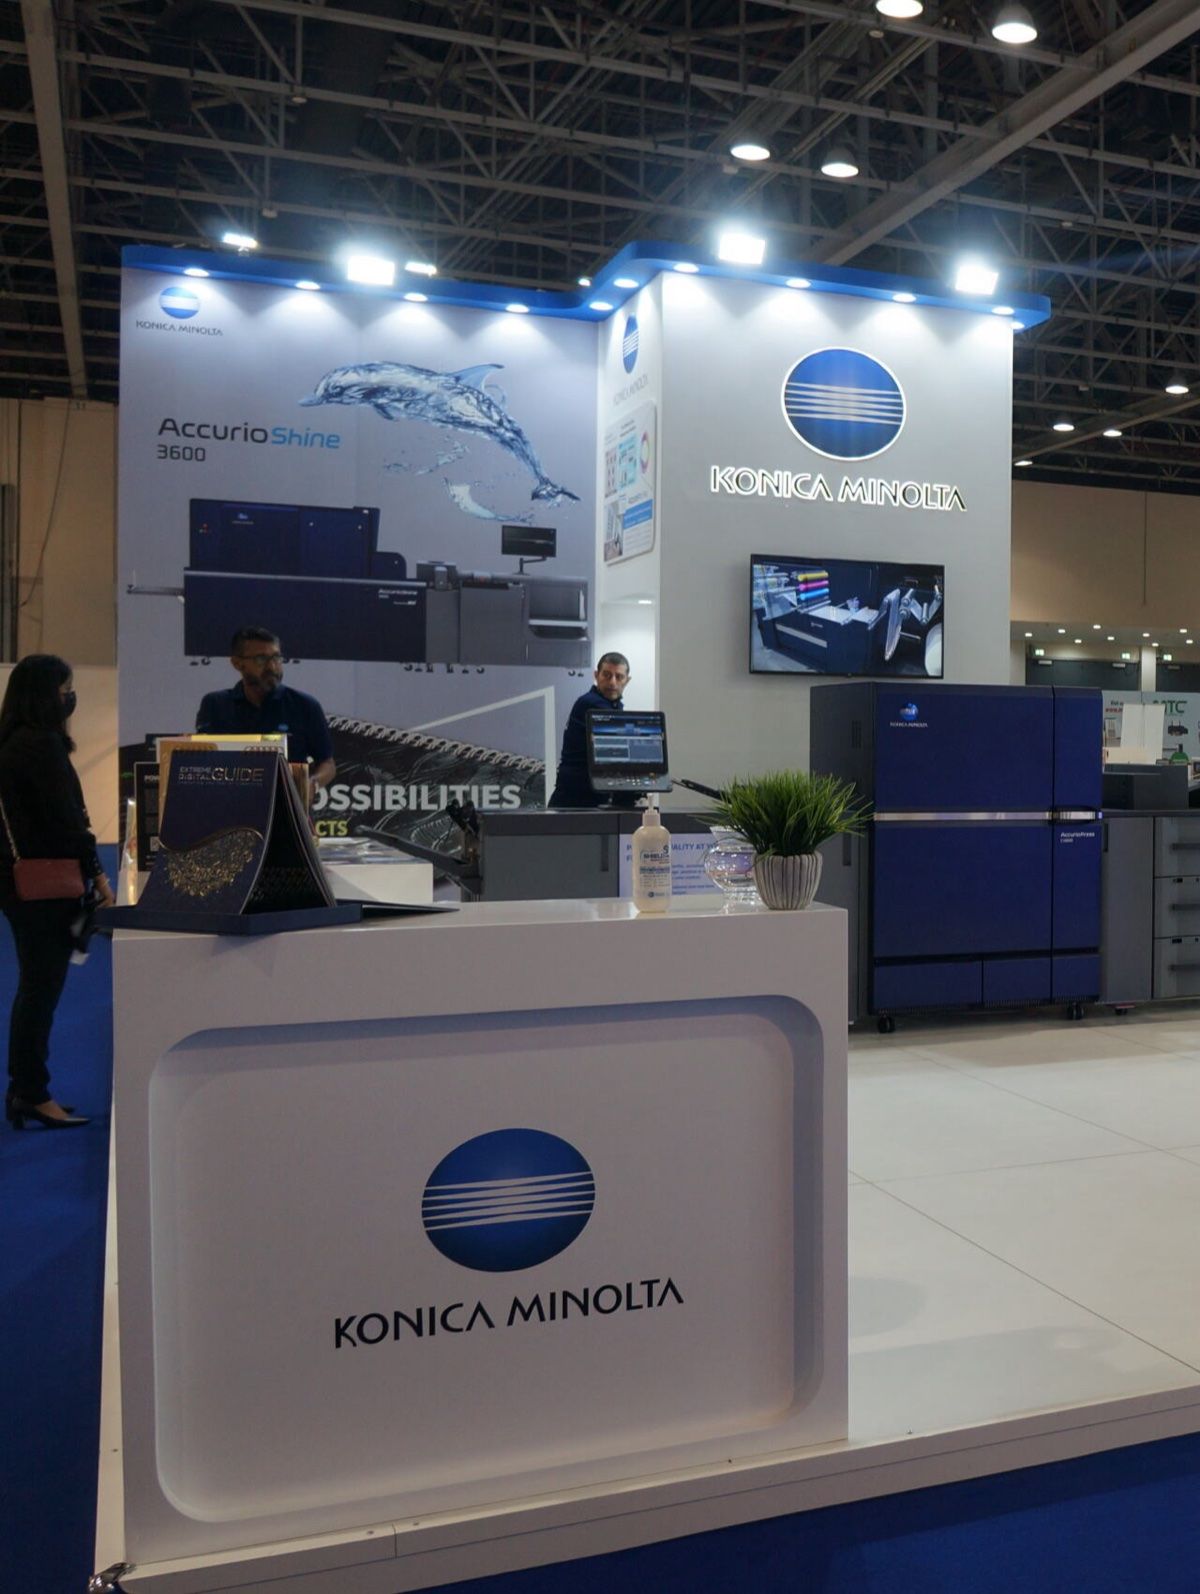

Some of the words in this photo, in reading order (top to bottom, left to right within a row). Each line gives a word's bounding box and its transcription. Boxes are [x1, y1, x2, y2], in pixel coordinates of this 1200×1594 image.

[136, 320, 175, 332] KONICA
[178, 325, 223, 337] MINOLTA
[157, 444, 206, 462] 3600
[710, 465, 834, 502] KONICA
[838, 476, 967, 512] MINOLTA
[178, 773, 212, 781] DIGITAL
[211, 767, 265, 782] GUIDE
[313, 784, 521, 811] OSSIBILITIES
[315, 820, 348, 837] CTS
[671, 843, 694, 851] ALITY
[334, 1300, 496, 1349] KONICA
[506, 1277, 685, 1327] MINOLTA
